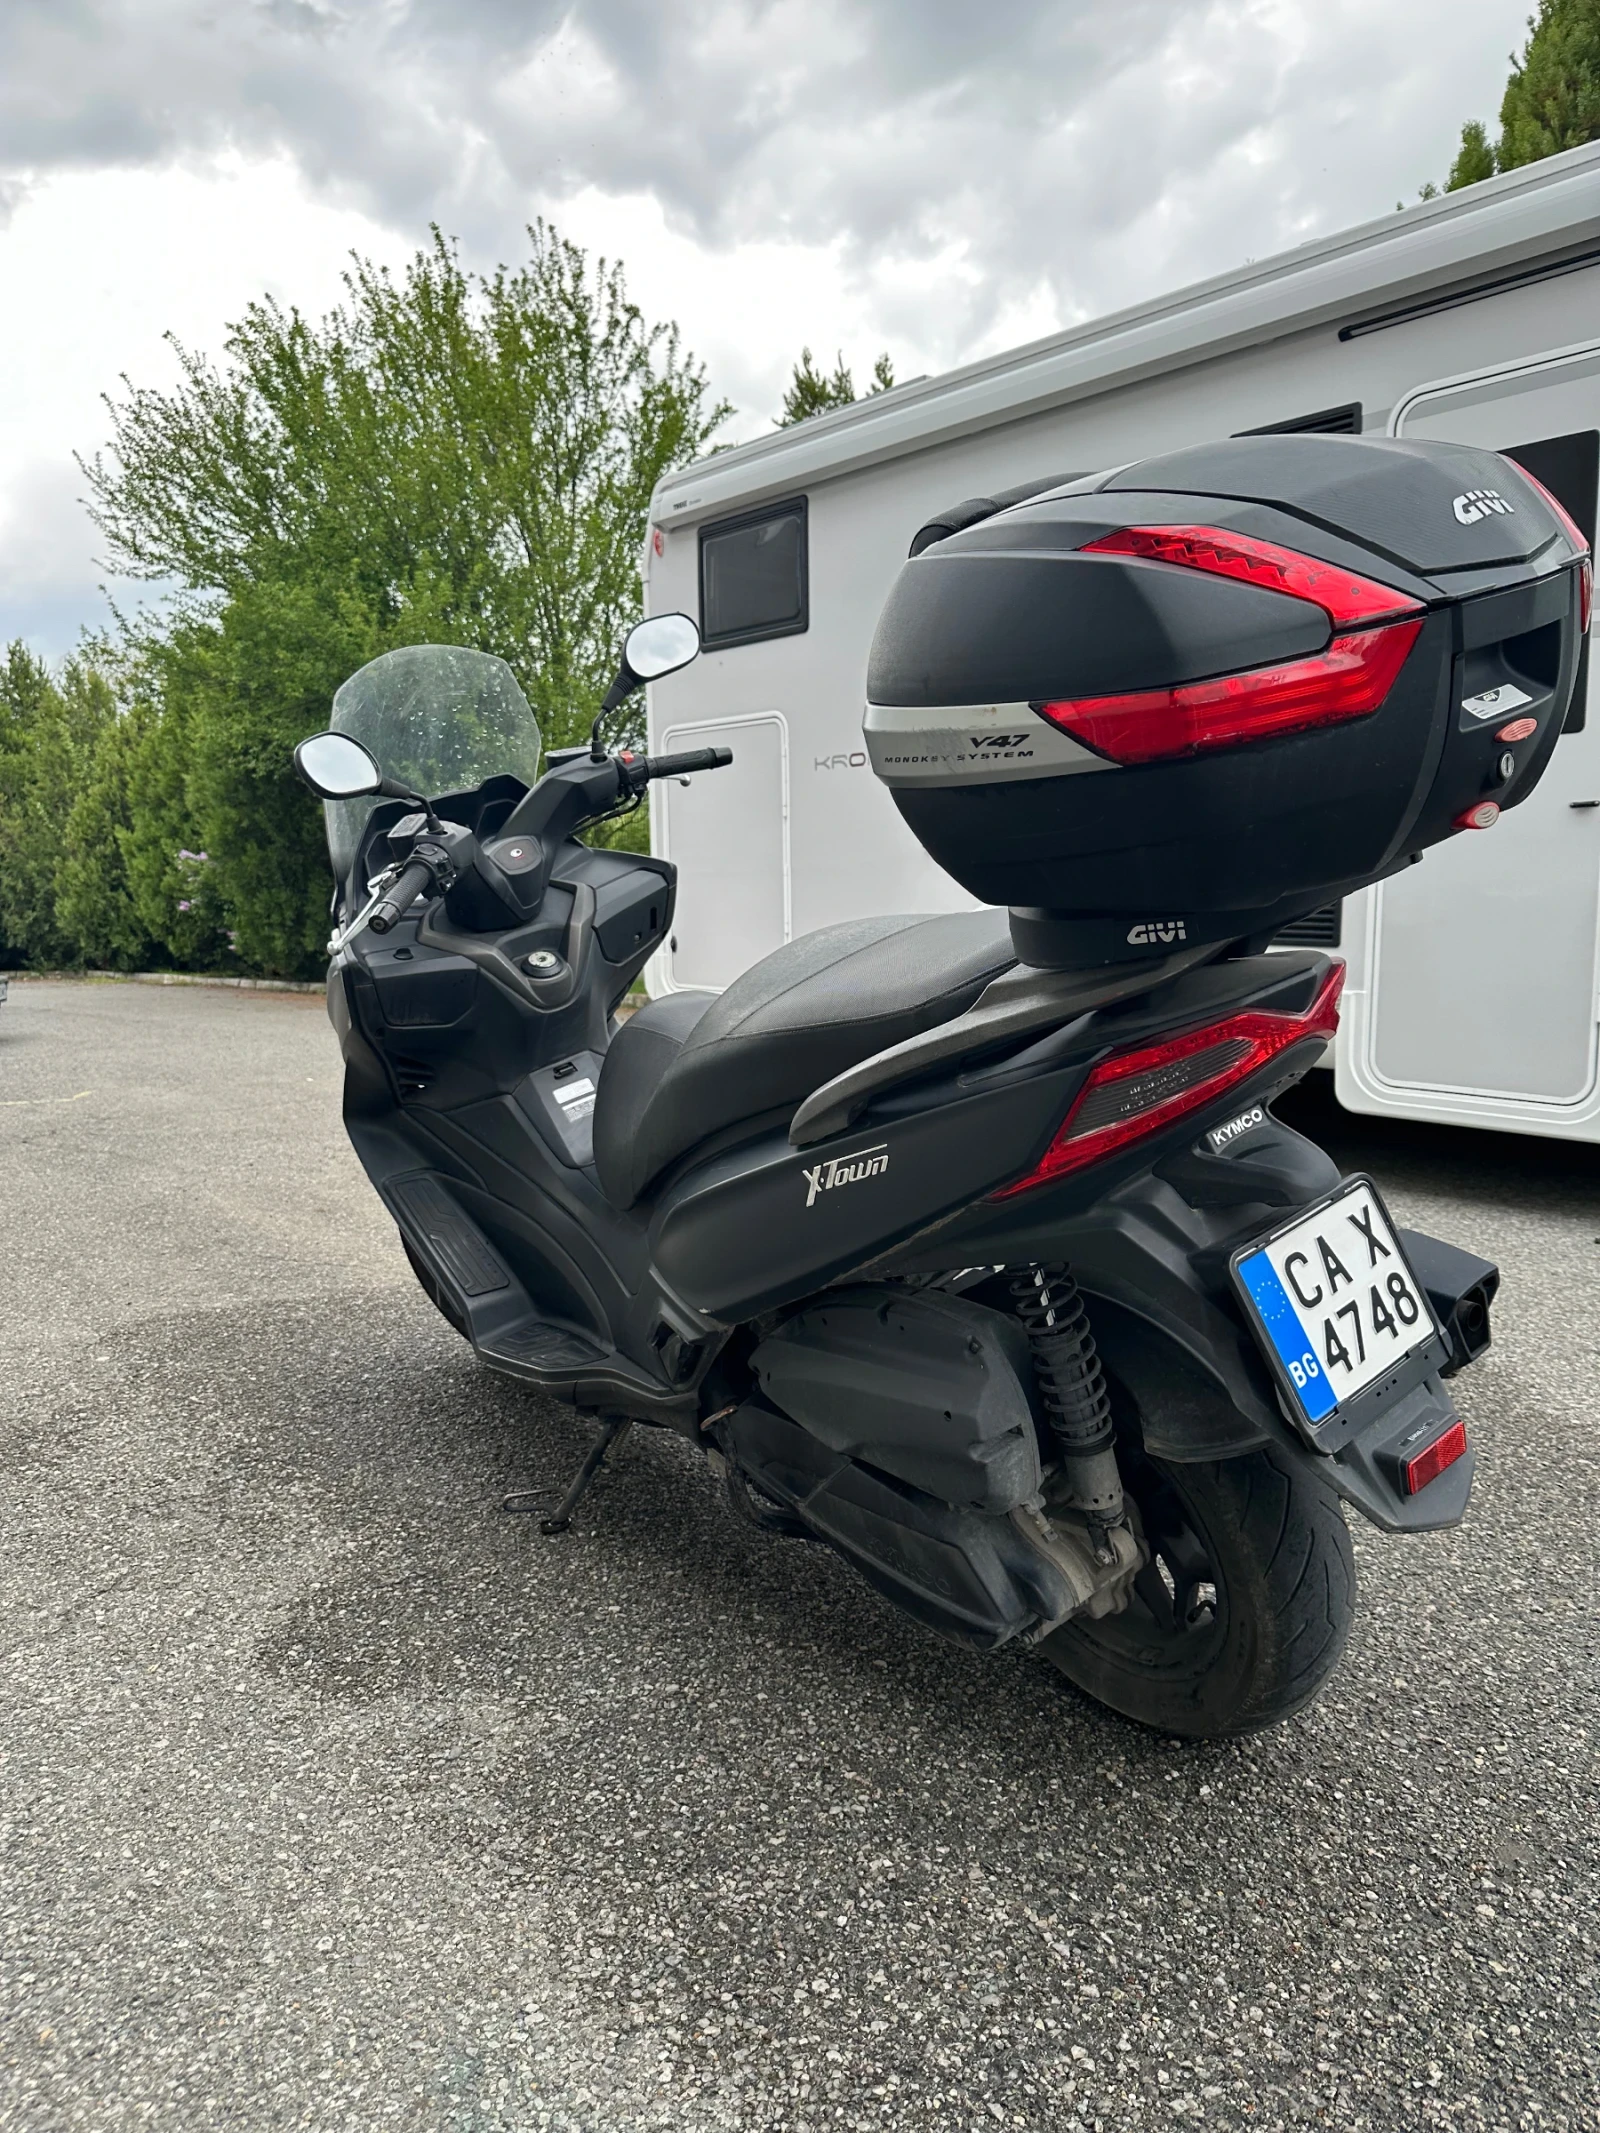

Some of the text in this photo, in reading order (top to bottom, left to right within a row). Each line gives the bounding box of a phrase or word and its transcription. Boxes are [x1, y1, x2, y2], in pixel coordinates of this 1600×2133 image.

[884, 750, 1034, 763] MONOKEY SYSTEM
[969, 733, 1031, 749] V47
[814, 752, 870, 771] KRO
[1212, 1109, 1262, 1146] KYMCO
[1284, 1204, 1391, 1309] CA X
[1323, 1272, 1419, 1374] 4748
[1288, 1352, 1319, 1389] BG
